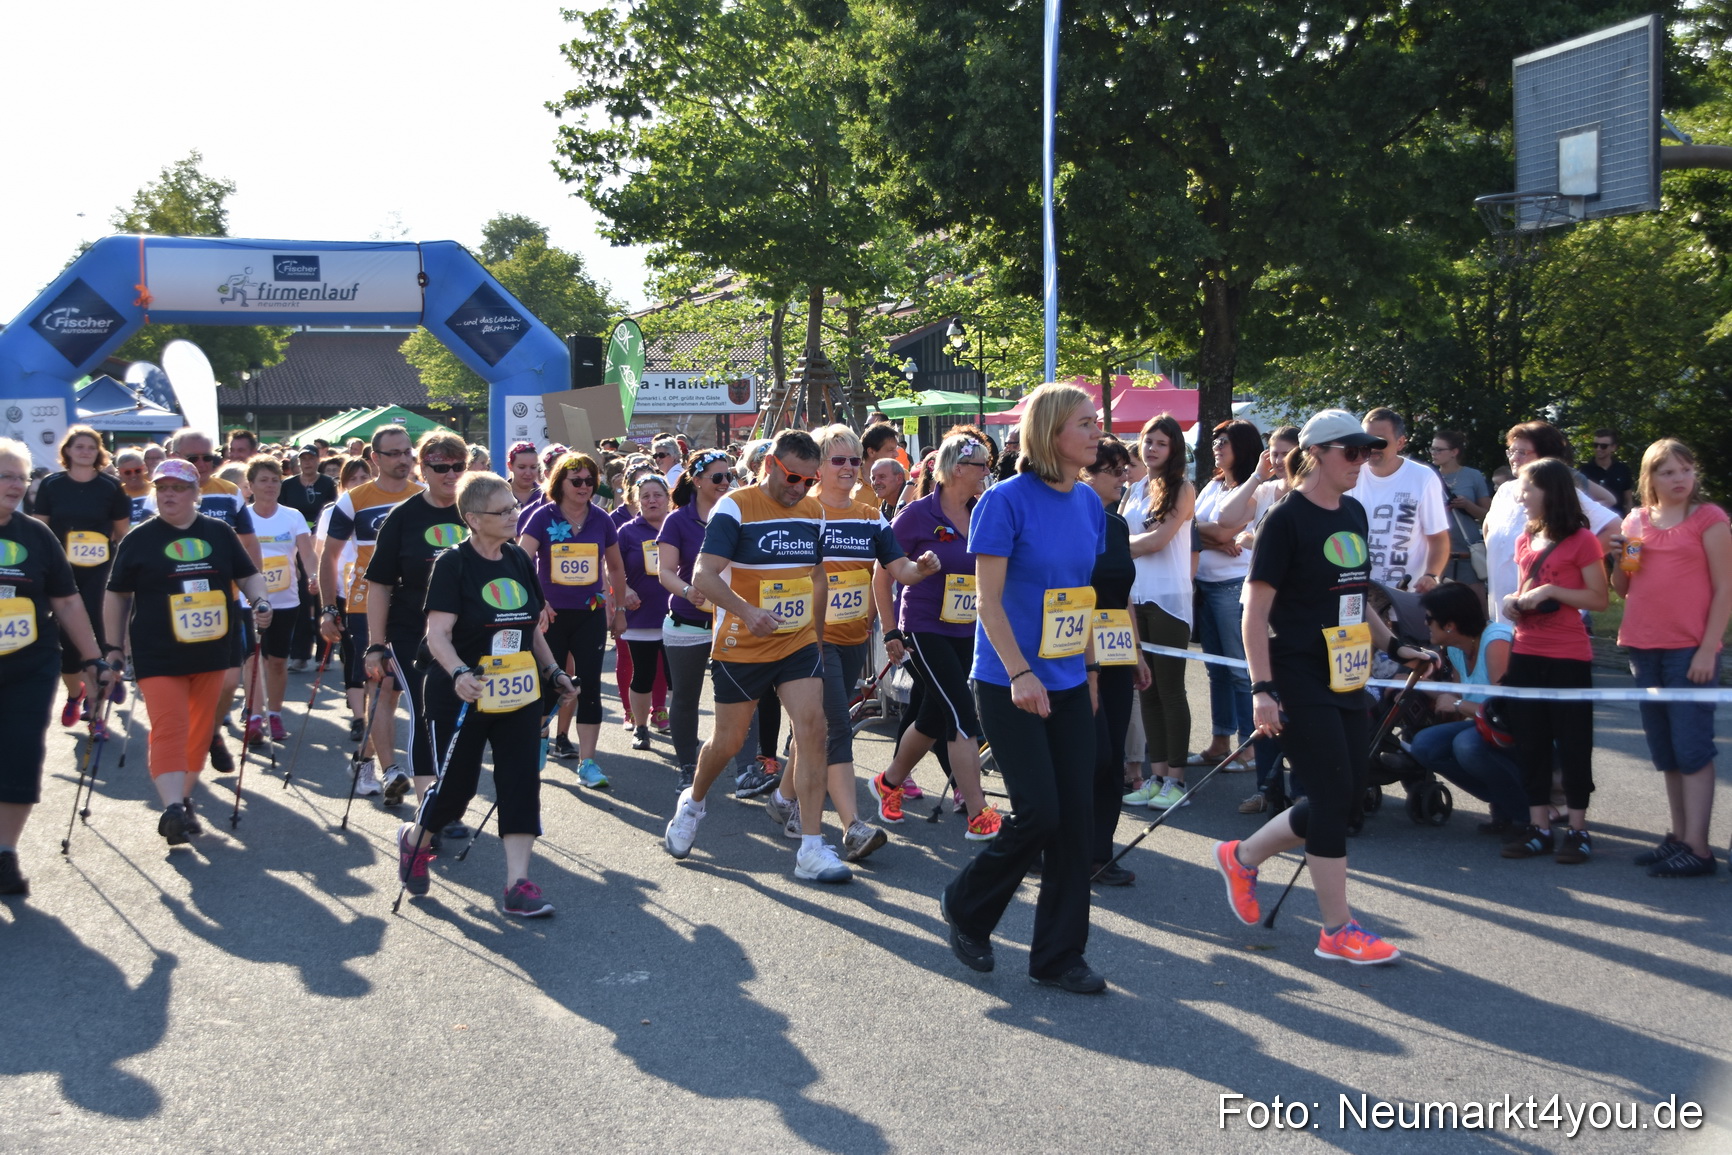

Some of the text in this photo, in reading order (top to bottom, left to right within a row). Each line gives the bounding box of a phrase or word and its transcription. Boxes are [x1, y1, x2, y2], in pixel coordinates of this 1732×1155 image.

[284, 264, 318, 273] Fischer
[257, 282, 360, 301] firmenlauf
[55, 316, 114, 328] Fischer
[201, 509, 228, 517] cher
[824, 534, 871, 546] Fischer
[1387, 503, 1418, 582] DENIM
[72, 545, 106, 558] 1245
[560, 560, 589, 574] 696
[773, 600, 805, 618] 458
[831, 591, 863, 609] 425
[180, 610, 222, 629] 1351
[1055, 614, 1084, 639] 734
[1097, 631, 1133, 650] 1248
[1335, 649, 1368, 674] 1344
[485, 674, 534, 697] 1350
